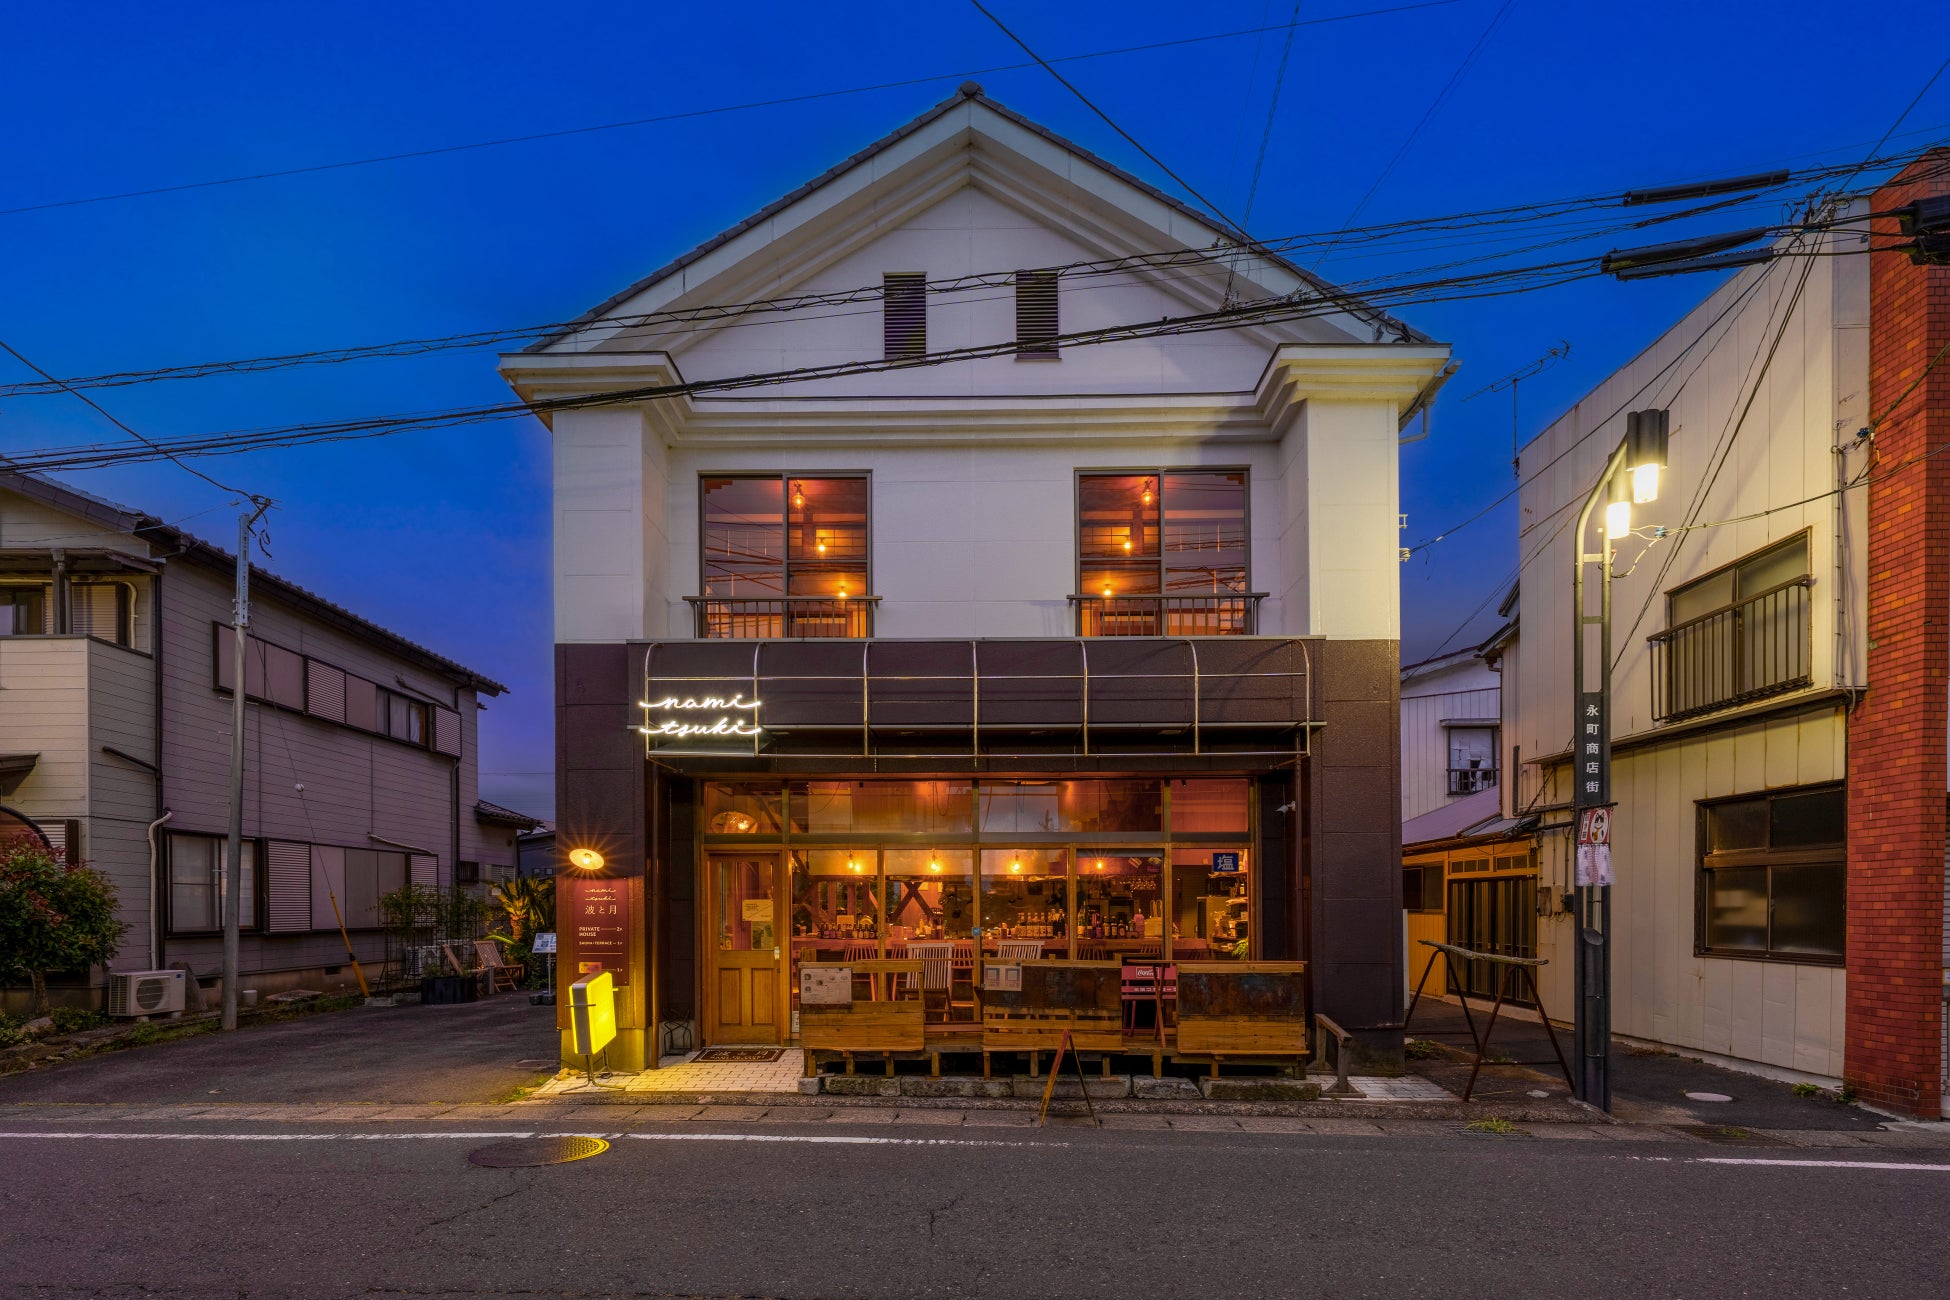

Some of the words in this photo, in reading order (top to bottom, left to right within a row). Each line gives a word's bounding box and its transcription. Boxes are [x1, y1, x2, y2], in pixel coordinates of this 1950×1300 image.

[639, 694, 761, 709] nami
[639, 717, 762, 737] tsuki
[1586, 704, 1600, 793] 永町商店街
[1217, 854, 1235, 871] 塩
[584, 904, 617, 915] 波と月
